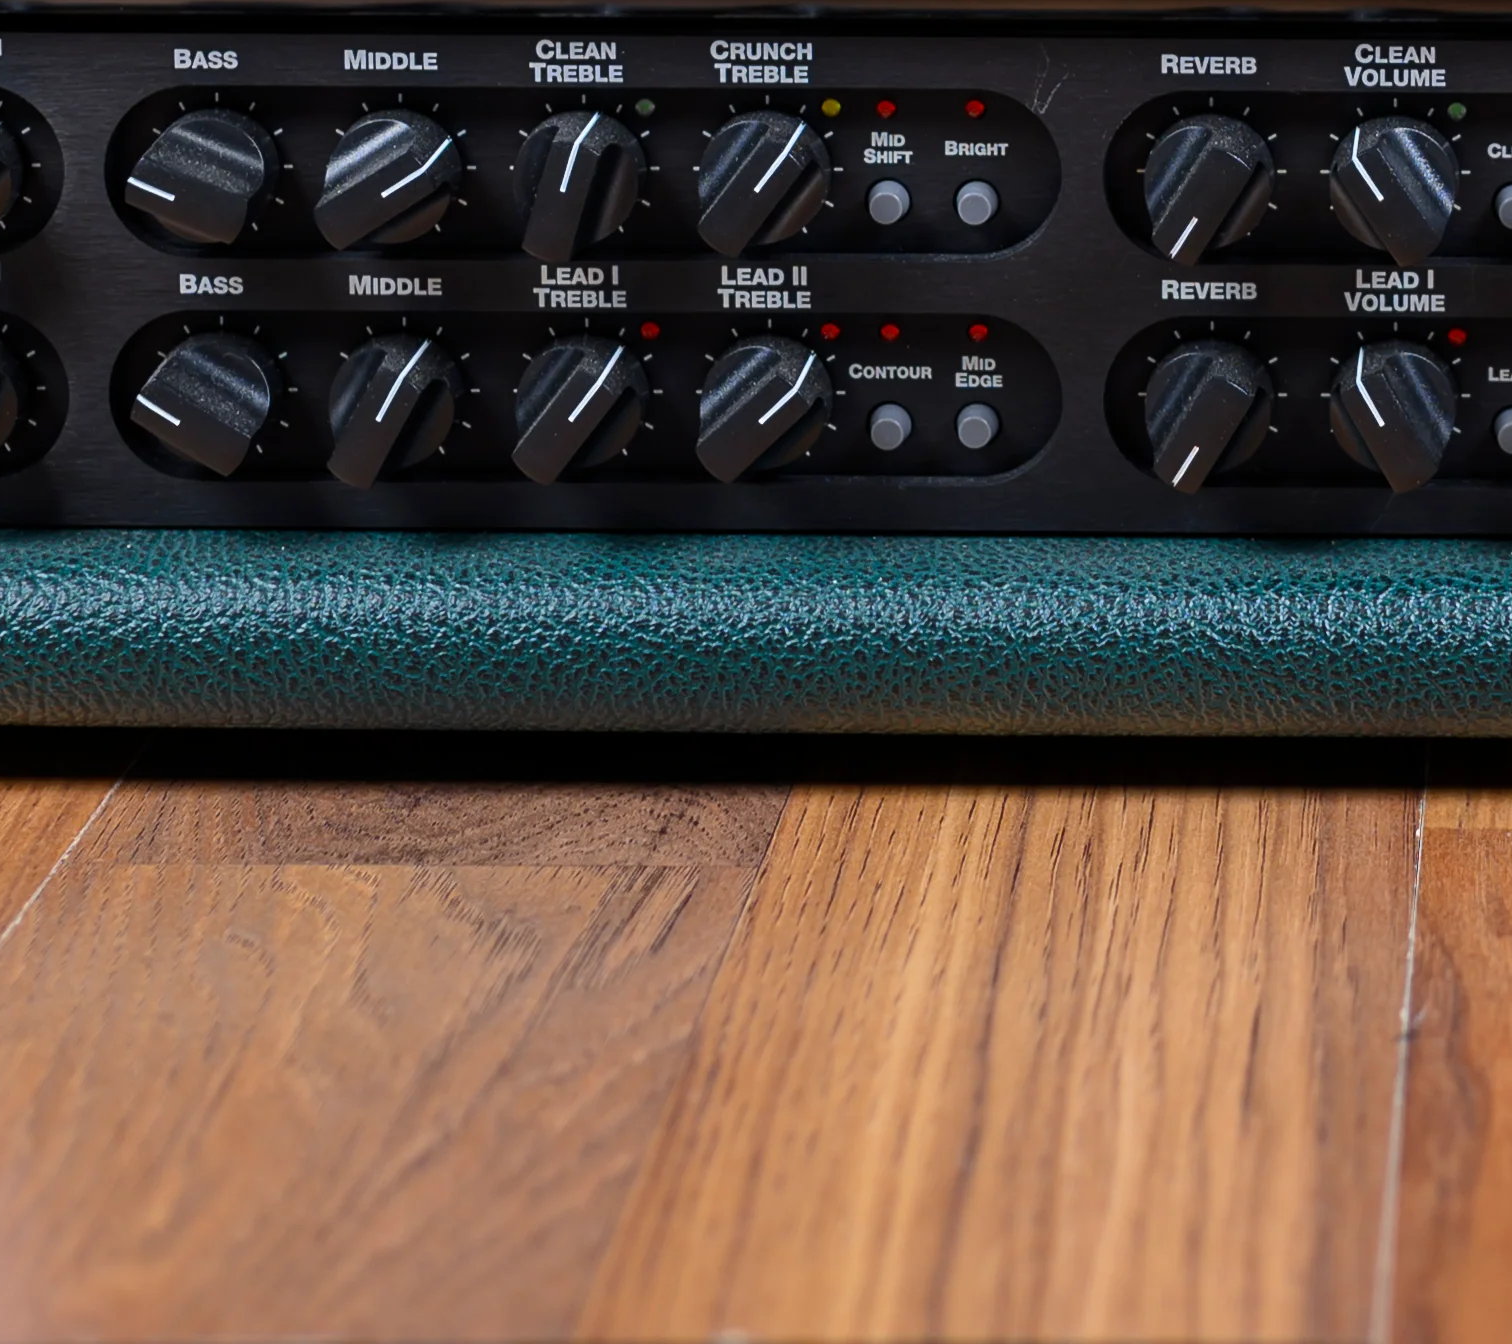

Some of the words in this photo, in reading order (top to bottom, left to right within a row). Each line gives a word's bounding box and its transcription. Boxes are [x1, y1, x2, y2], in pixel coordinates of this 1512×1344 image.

[173, 48, 239, 70] BASS
[343, 49, 439, 71] MIDDLE
[535, 39, 617, 60] CLEAN
[709, 39, 813, 61] CRUNCH
[1354, 43, 1436, 64] CLEAN
[528, 61, 624, 83] TREBLE
[713, 62, 809, 84] TREBLE
[1160, 53, 1258, 75] REVERB
[1343, 66, 1447, 87] VOLUME
[871, 131, 906, 147] MID
[944, 140, 1009, 157] BRIGHT
[863, 147, 914, 165] SHIFT
[179, 273, 244, 295] BASS
[348, 274, 443, 296] MIDDLE
[540, 264, 605, 286] LEAD
[721, 265, 785, 286] LEAD
[1356, 269, 1420, 290] LEAD
[532, 287, 627, 308] TREBLE
[716, 288, 812, 309] TREBLE
[1161, 279, 1257, 300] REVERB
[1344, 291, 1446, 313] VOLUME
[848, 363, 933, 380] CONTOUR
[961, 355, 997, 371] MID
[955, 372, 1003, 388] EDGE
